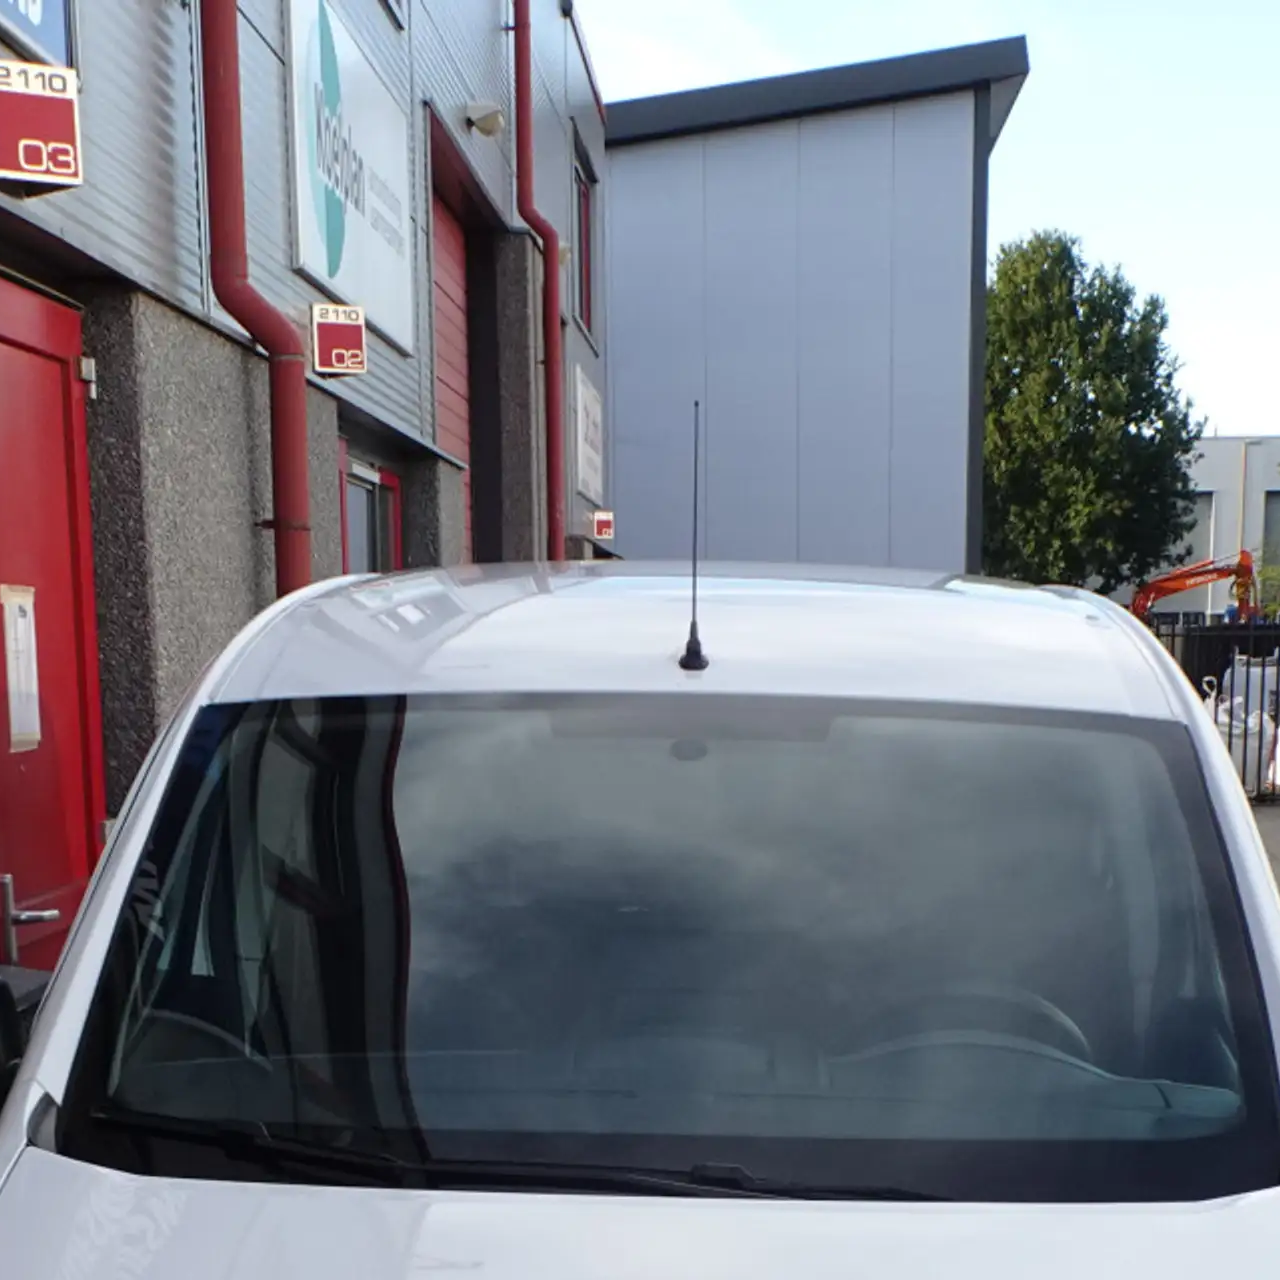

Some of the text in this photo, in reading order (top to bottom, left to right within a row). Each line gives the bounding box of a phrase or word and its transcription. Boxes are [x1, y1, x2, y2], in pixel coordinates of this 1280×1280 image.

[18, 138, 76, 174] 03
[320, 308, 359, 322] 2110
[332, 348, 363, 368] 02
